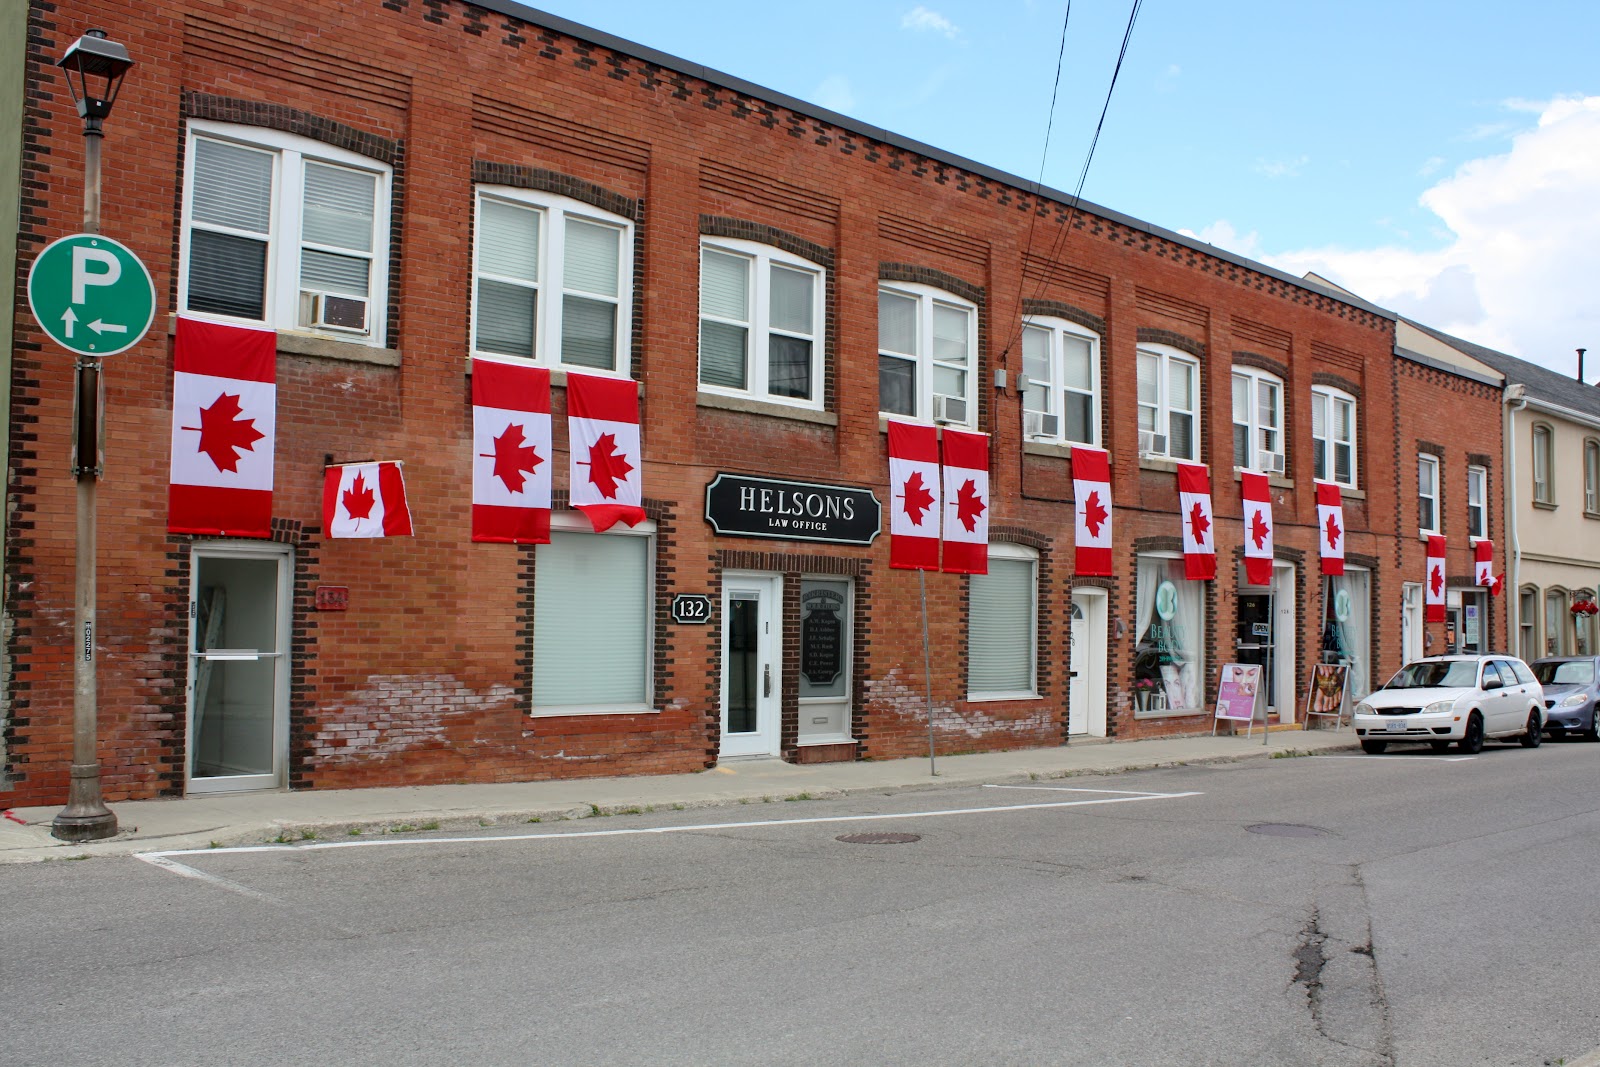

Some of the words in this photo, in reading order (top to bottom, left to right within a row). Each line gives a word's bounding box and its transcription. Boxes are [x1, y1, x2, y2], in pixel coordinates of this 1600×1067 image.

[72, 246, 122, 304] P
[739, 486, 855, 520] HELSONS
[768, 518, 789, 528] LAW
[792, 520, 827, 531] OFFICE
[679, 600, 704, 617] 132
